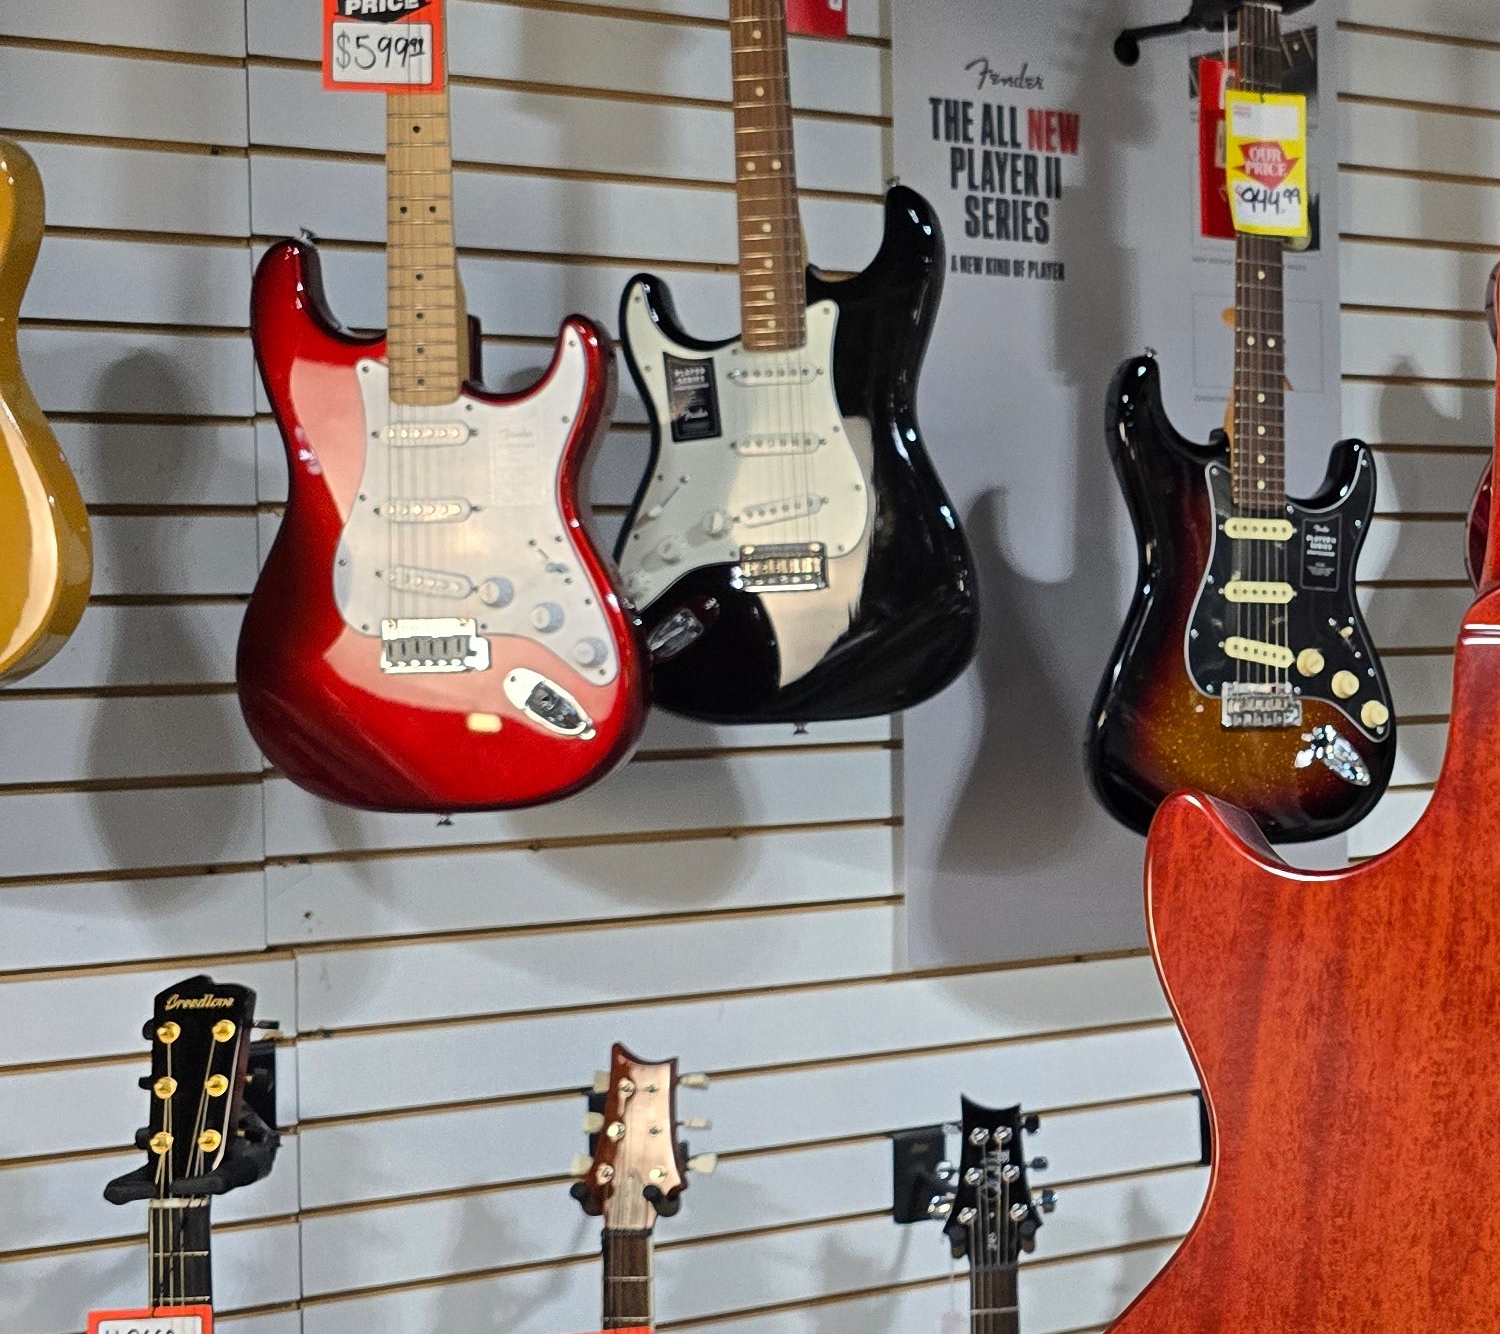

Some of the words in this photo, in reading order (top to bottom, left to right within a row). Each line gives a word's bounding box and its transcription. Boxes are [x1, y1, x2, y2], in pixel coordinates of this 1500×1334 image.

[965, 57, 1045, 90] Fender
[929, 97, 974, 143] THE
[981, 103, 1022, 149] ALL
[1027, 108, 1080, 156] NEW
[1245, 161, 1286, 177] PRICE
[1249, 146, 1282, 162] OUR
[950, 146, 1038, 197] PLAYER
[1045, 157, 1062, 199] II
[965, 195, 1050, 245] SERIES
[951, 255, 958, 273] A
[960, 255, 983, 275] NEW
[1028, 260, 1065, 281] PLAYER
